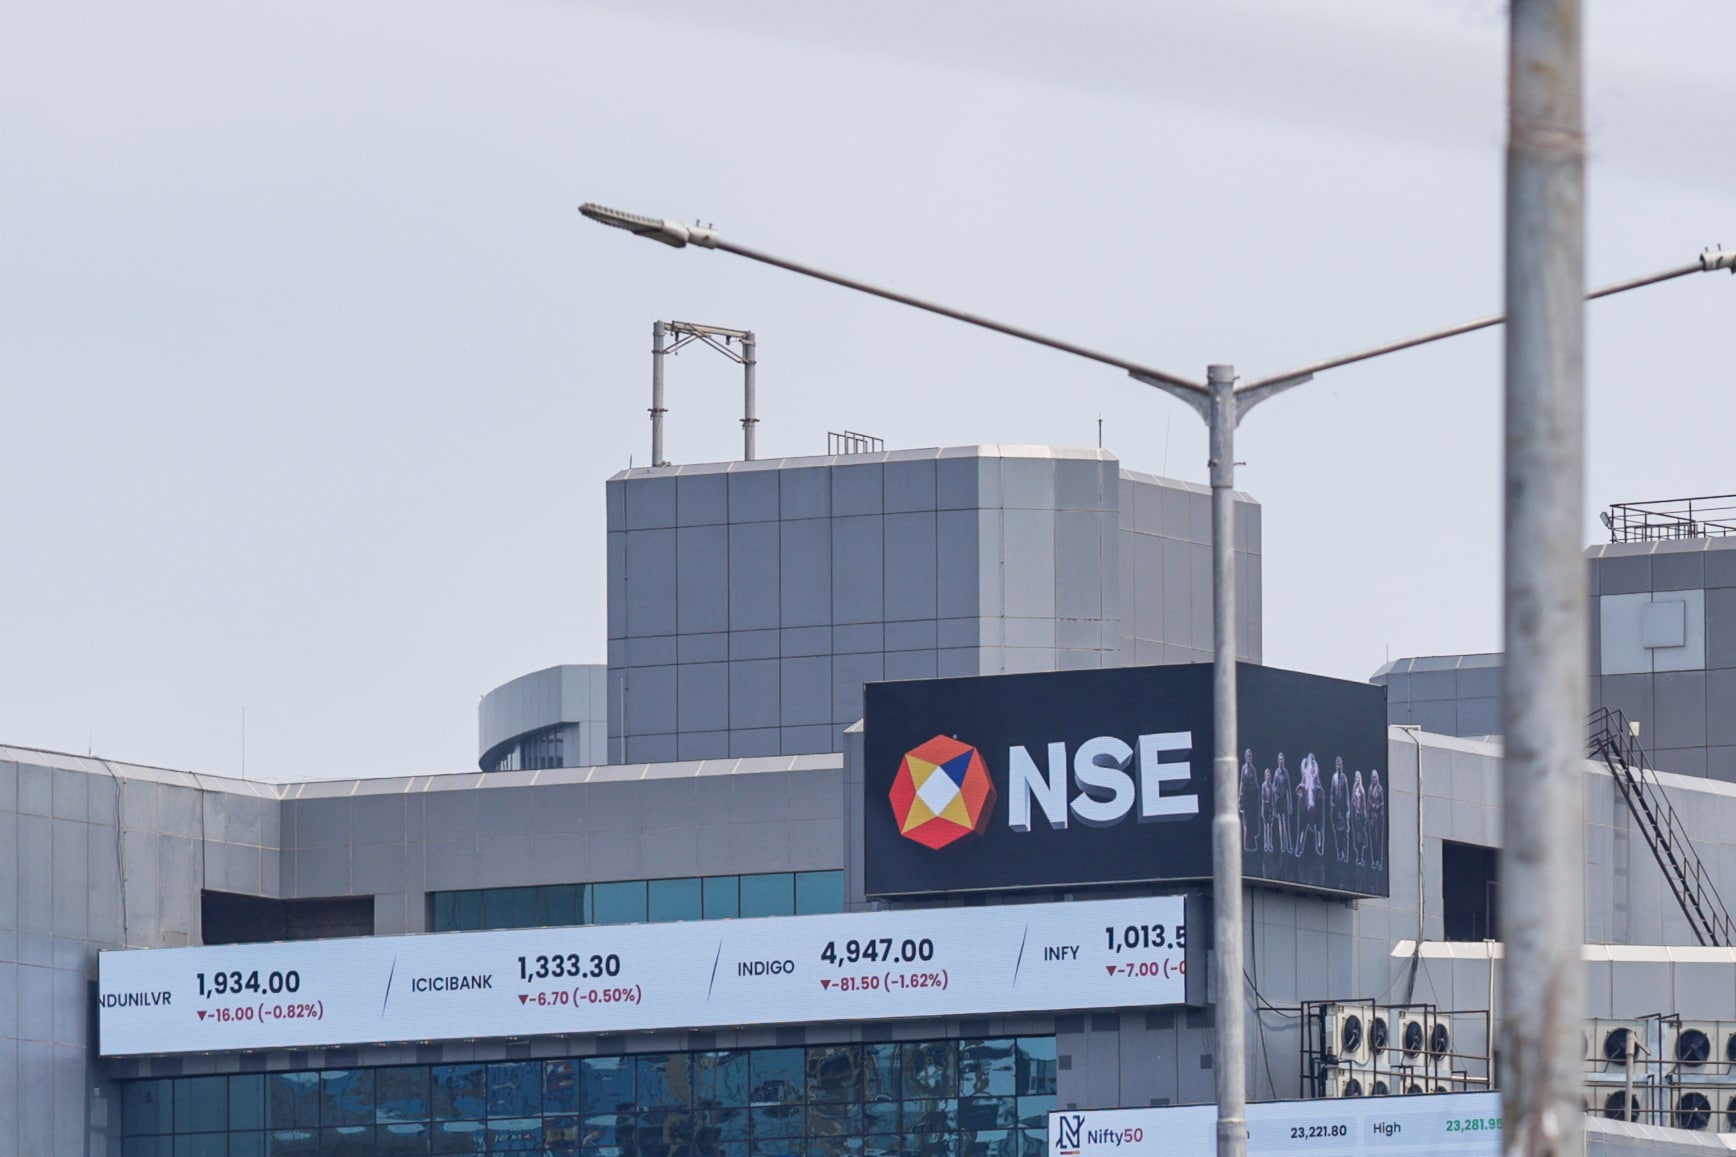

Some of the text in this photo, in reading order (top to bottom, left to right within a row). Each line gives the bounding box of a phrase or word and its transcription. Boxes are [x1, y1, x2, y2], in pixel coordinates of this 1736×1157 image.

[1009, 731, 1199, 832] NSE
[1105, 924, 1185, 953] 1,013.5
[820, 938, 934, 967] 4,947.00
[1044, 945, 1080, 961] INFY
[518, 954, 621, 983] 1,333.30
[738, 960, 795, 976] INDIGO
[1117, 961, 1159, 977] -7.00
[197, 970, 301, 999] 1,934.00
[412, 974, 493, 993] ICICIBANK
[831, 969, 949, 992] -81.50 (-1.62%)
[529, 984, 642, 1008] -6.70 (-0.50%)
[207, 1000, 324, 1023] -16.00 (-0.82%)
[1087, 1128, 1143, 1147] Nifty50
[1290, 1125, 1347, 1140] 23,221.80
[1373, 1122, 1401, 1136] High
